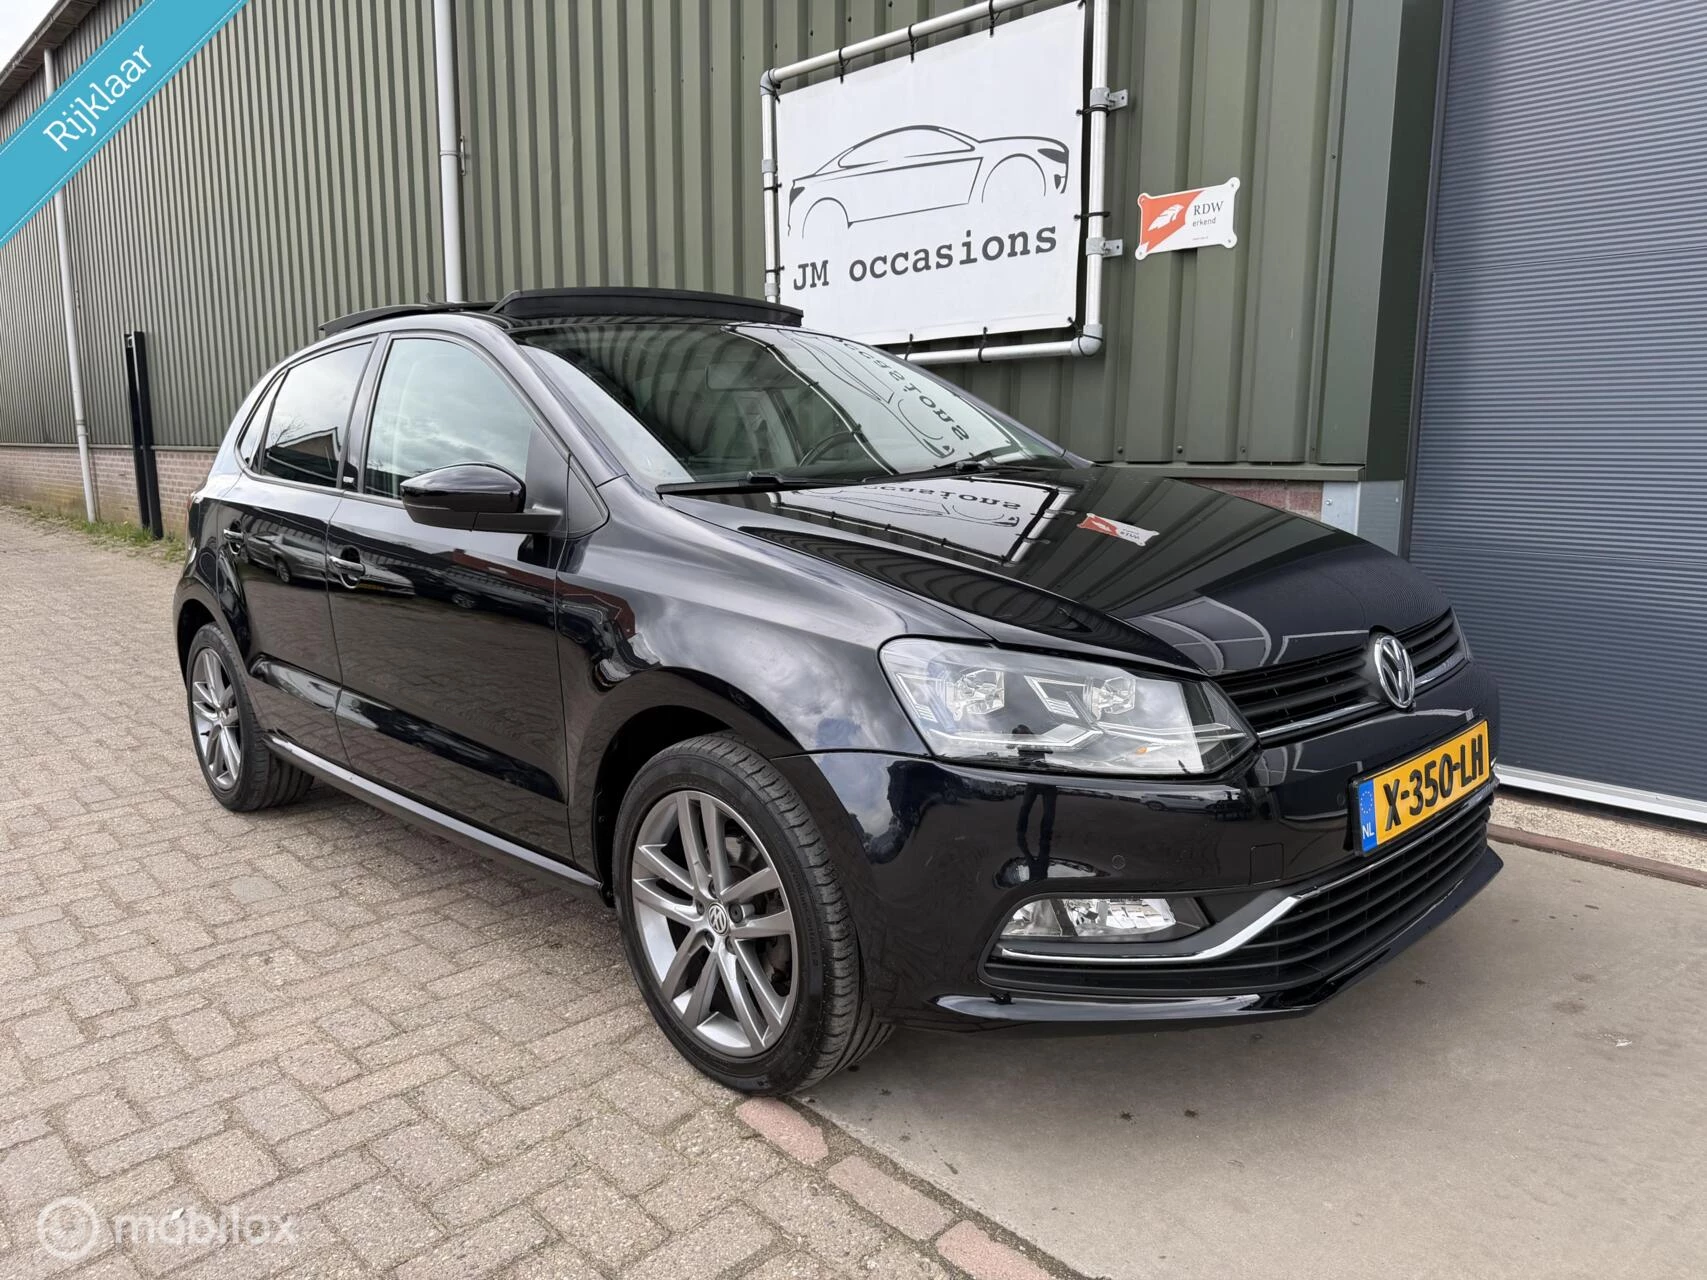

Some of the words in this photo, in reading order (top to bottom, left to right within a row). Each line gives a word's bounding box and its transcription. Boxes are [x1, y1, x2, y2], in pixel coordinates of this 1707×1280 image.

[1193, 201, 1224, 216] RDW
[1192, 217, 1217, 227] erkend
[793, 259, 830, 291] JM
[848, 225, 1058, 282] occasions
[1383, 733, 1484, 832] X-350-LH
[1362, 821, 1376, 840] NL
